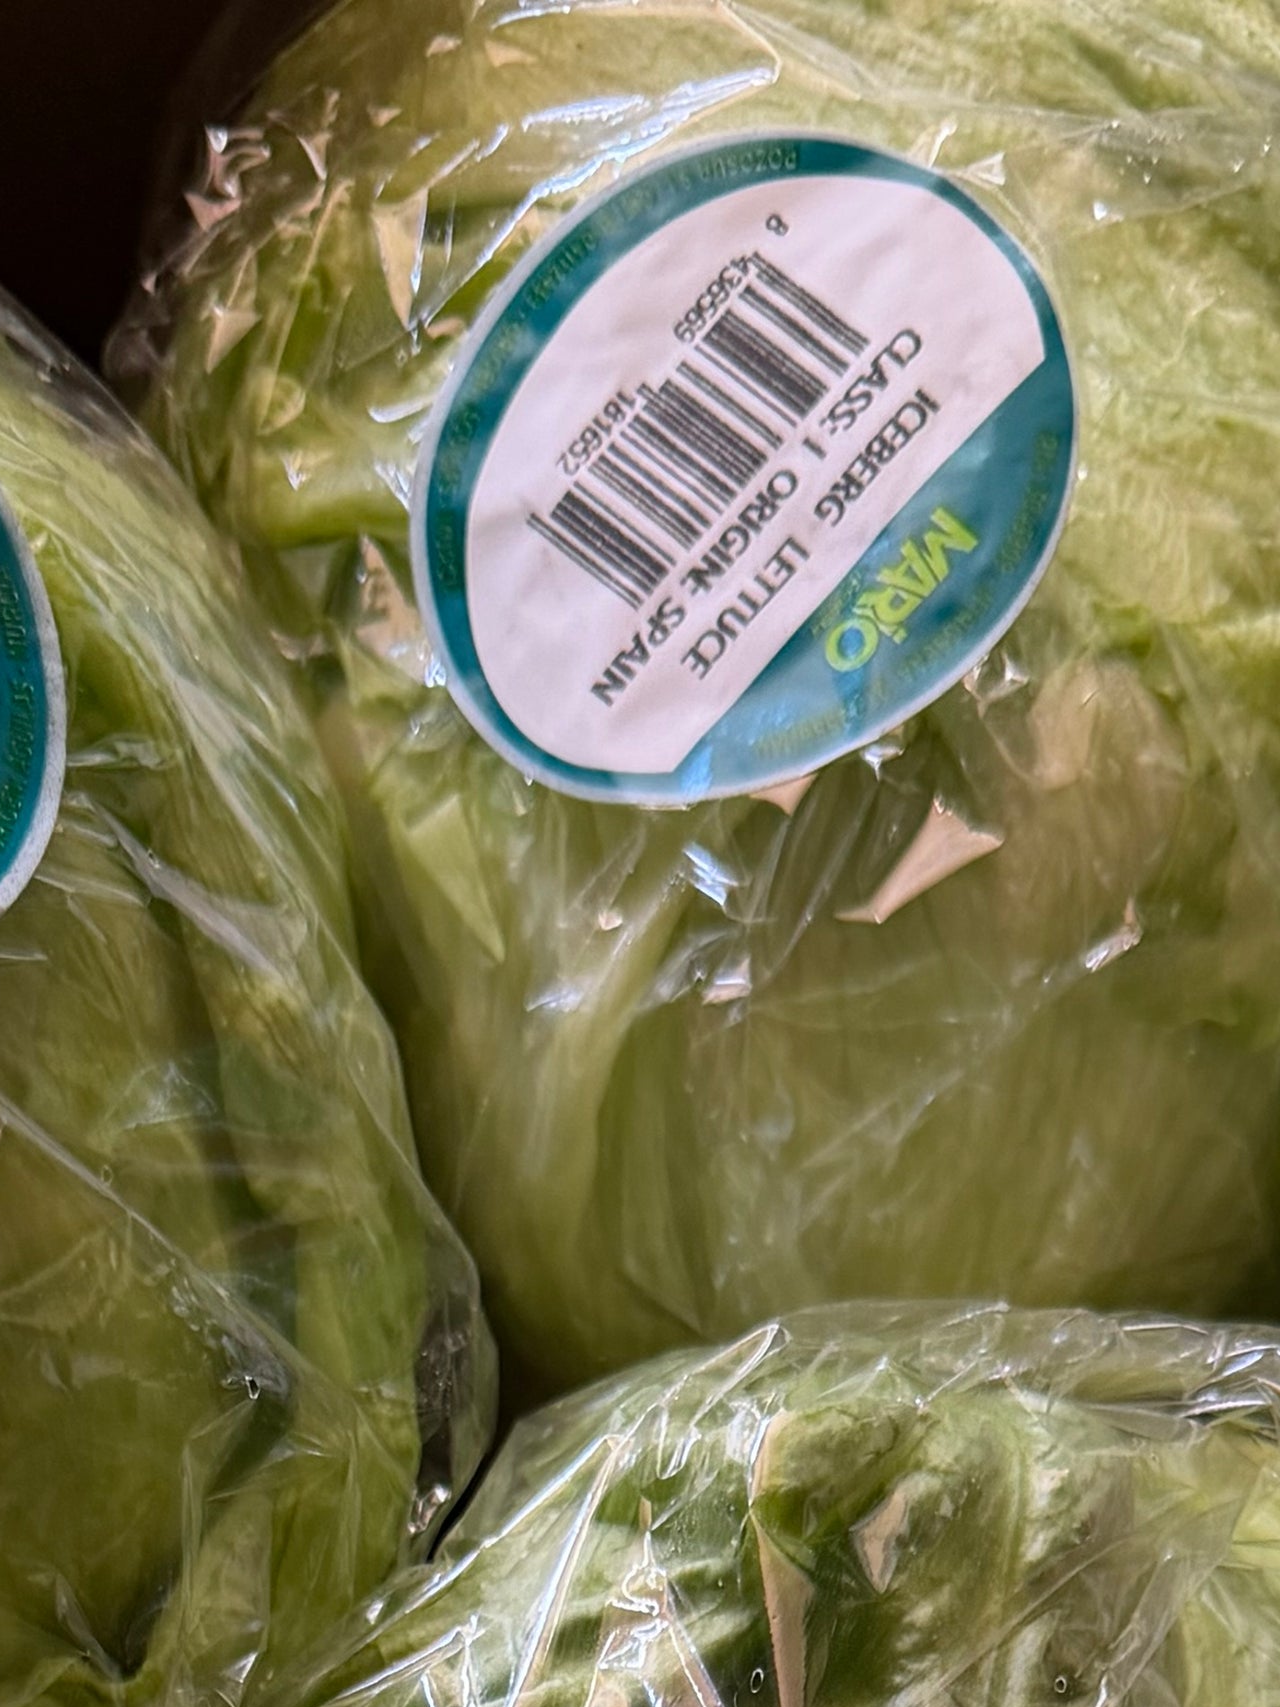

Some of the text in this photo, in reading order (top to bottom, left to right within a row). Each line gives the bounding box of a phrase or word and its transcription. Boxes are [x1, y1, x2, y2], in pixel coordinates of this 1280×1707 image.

[765, 212, 788, 235] 8
[673, 255, 748, 341] 436569
[557, 389, 635, 474] 181652
[814, 388, 939, 526] ICEBERG
[591, 328, 921, 705] CLASS: I ORIGIN: SPAIN
[680, 534, 809, 679] LETTUCE
